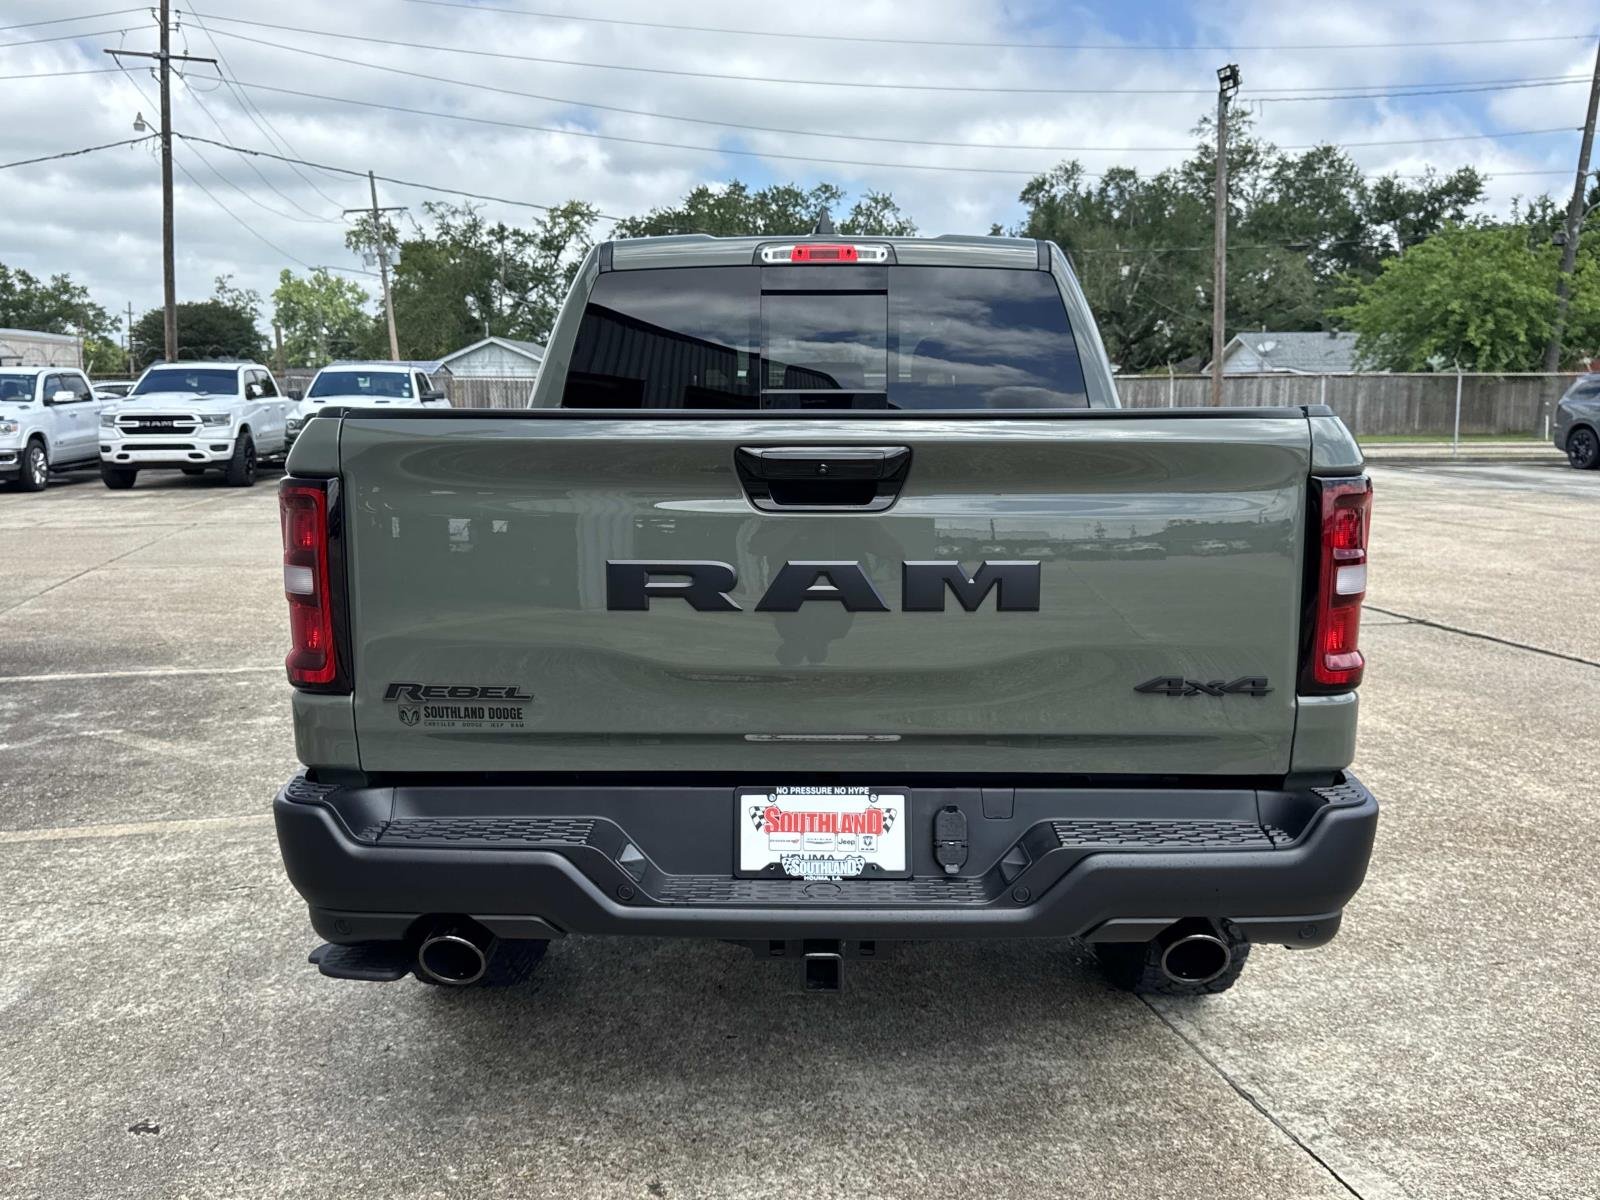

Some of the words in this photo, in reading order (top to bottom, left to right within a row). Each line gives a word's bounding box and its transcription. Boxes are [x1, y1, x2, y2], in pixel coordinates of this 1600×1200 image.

[606, 559, 1042, 612] RAM
[384, 683, 534, 702] REBEL
[423, 705, 485, 720] SOUTHLAND
[488, 707, 524, 720] DODGE
[776, 786, 788, 795] NO
[790, 786, 833, 795] PRESSURE
[834, 786, 847, 795] NO
[848, 786, 870, 795] HYPE
[764, 806, 883, 835] SOUTHLAND
[838, 838, 856, 846] Jeep
[790, 858, 858, 876] SOUTHLAND
